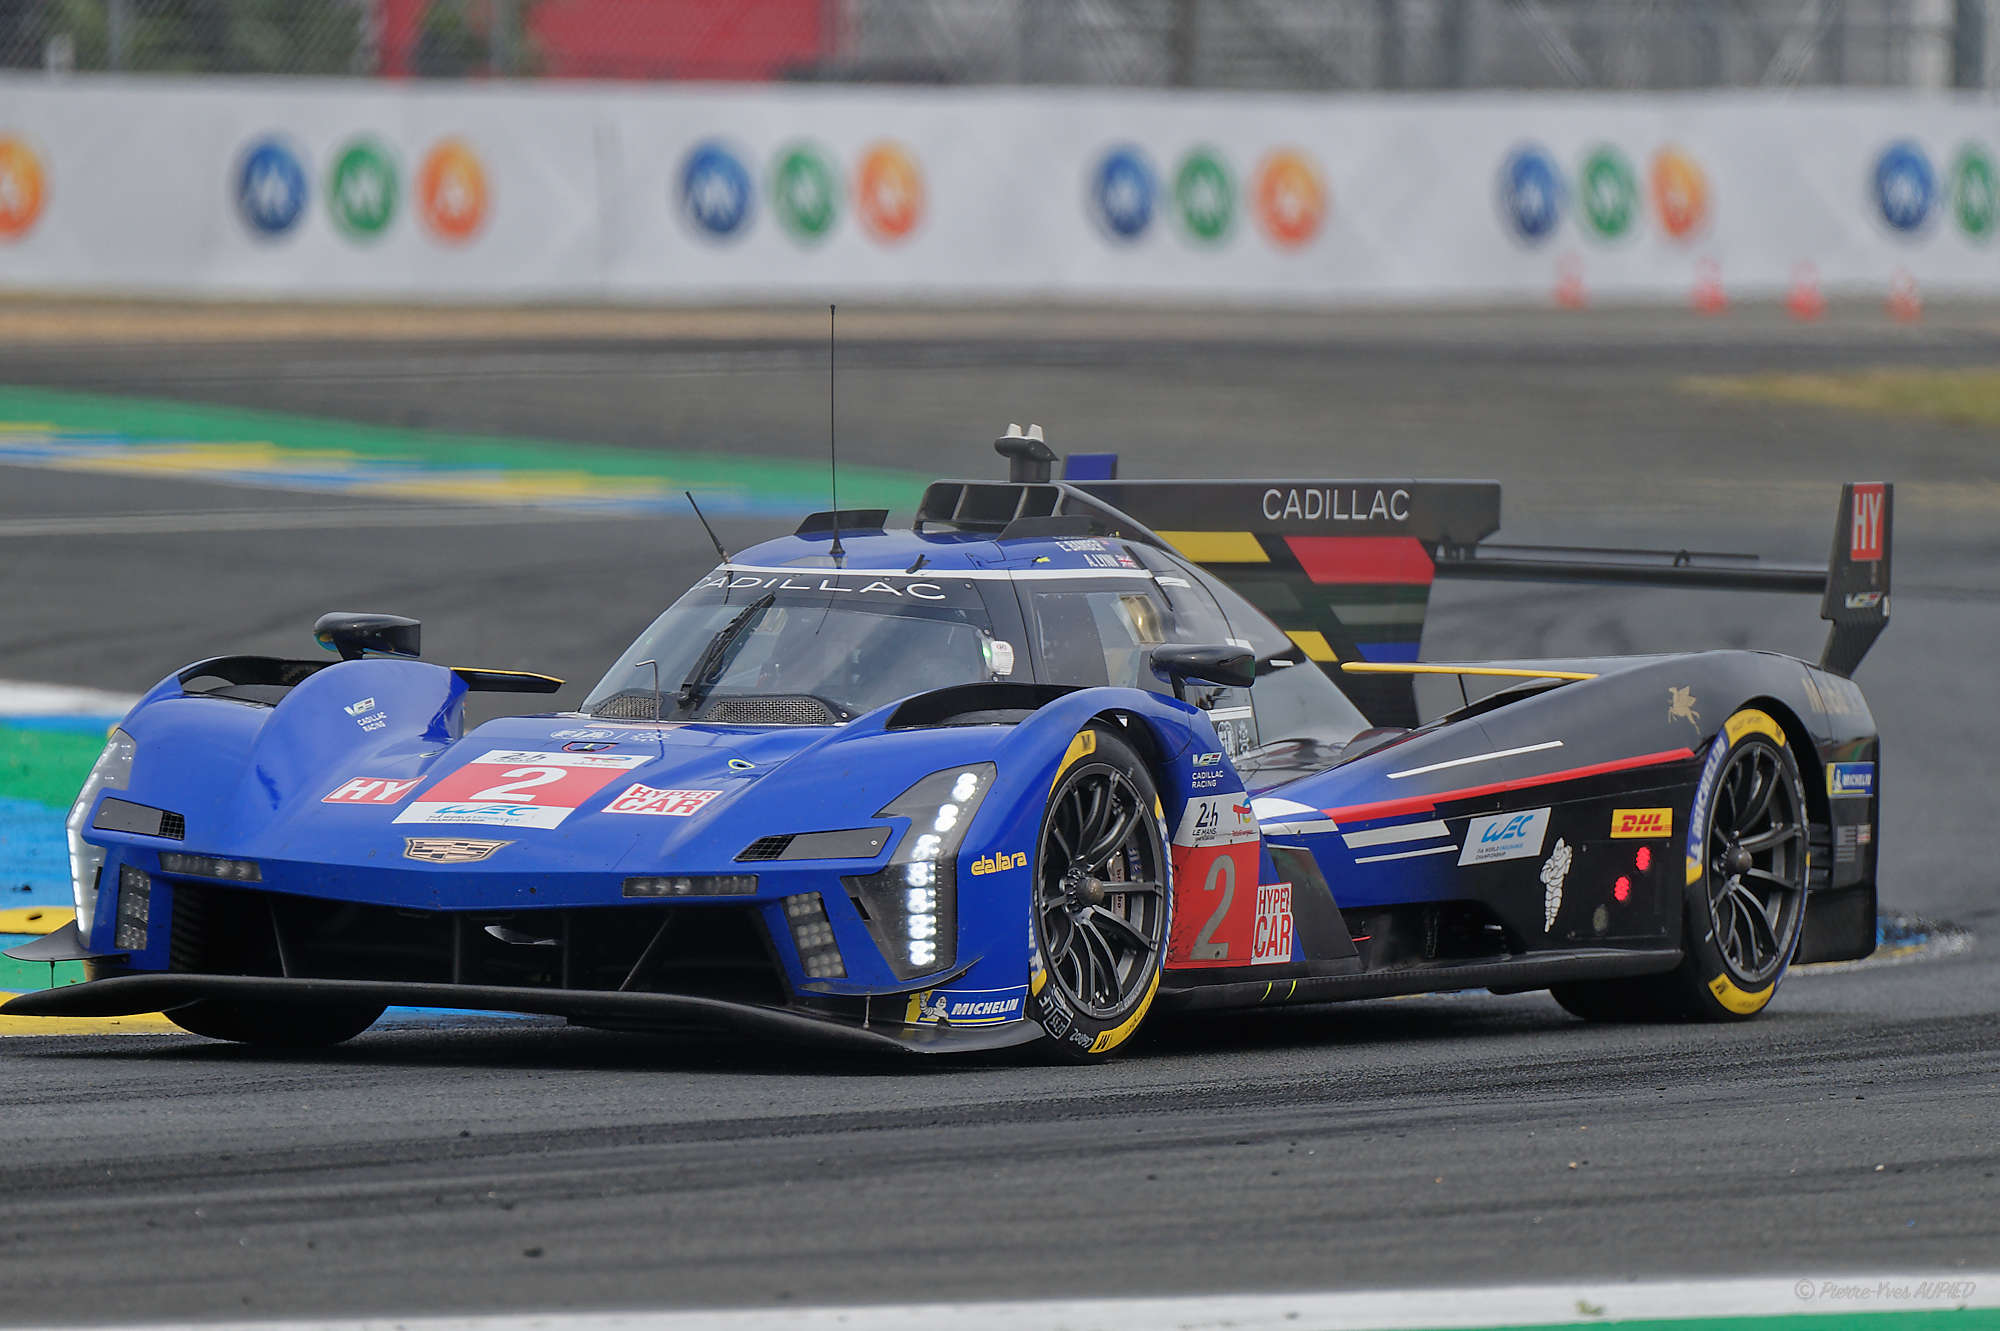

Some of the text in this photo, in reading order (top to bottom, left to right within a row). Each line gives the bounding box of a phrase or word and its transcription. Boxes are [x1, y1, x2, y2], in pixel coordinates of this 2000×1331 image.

[1262, 488, 1410, 521] CADILLAC
[1852, 492, 1882, 551] HY
[467, 766, 568, 802] 2
[1191, 770, 1224, 780] CADILLAC
[1191, 780, 1217, 789] RACING
[329, 779, 419, 801] HY
[628, 785, 717, 801] HYPER
[611, 797, 704, 814] CAR
[1480, 814, 1534, 843] WEC
[1620, 814, 1663, 832] DHL
[970, 851, 1028, 876] dallara
[1189, 854, 1236, 960] 2
[1258, 887, 1290, 915] HYPER
[1254, 913, 1292, 959] CAR
[951, 998, 1020, 1016] MICHELIN
